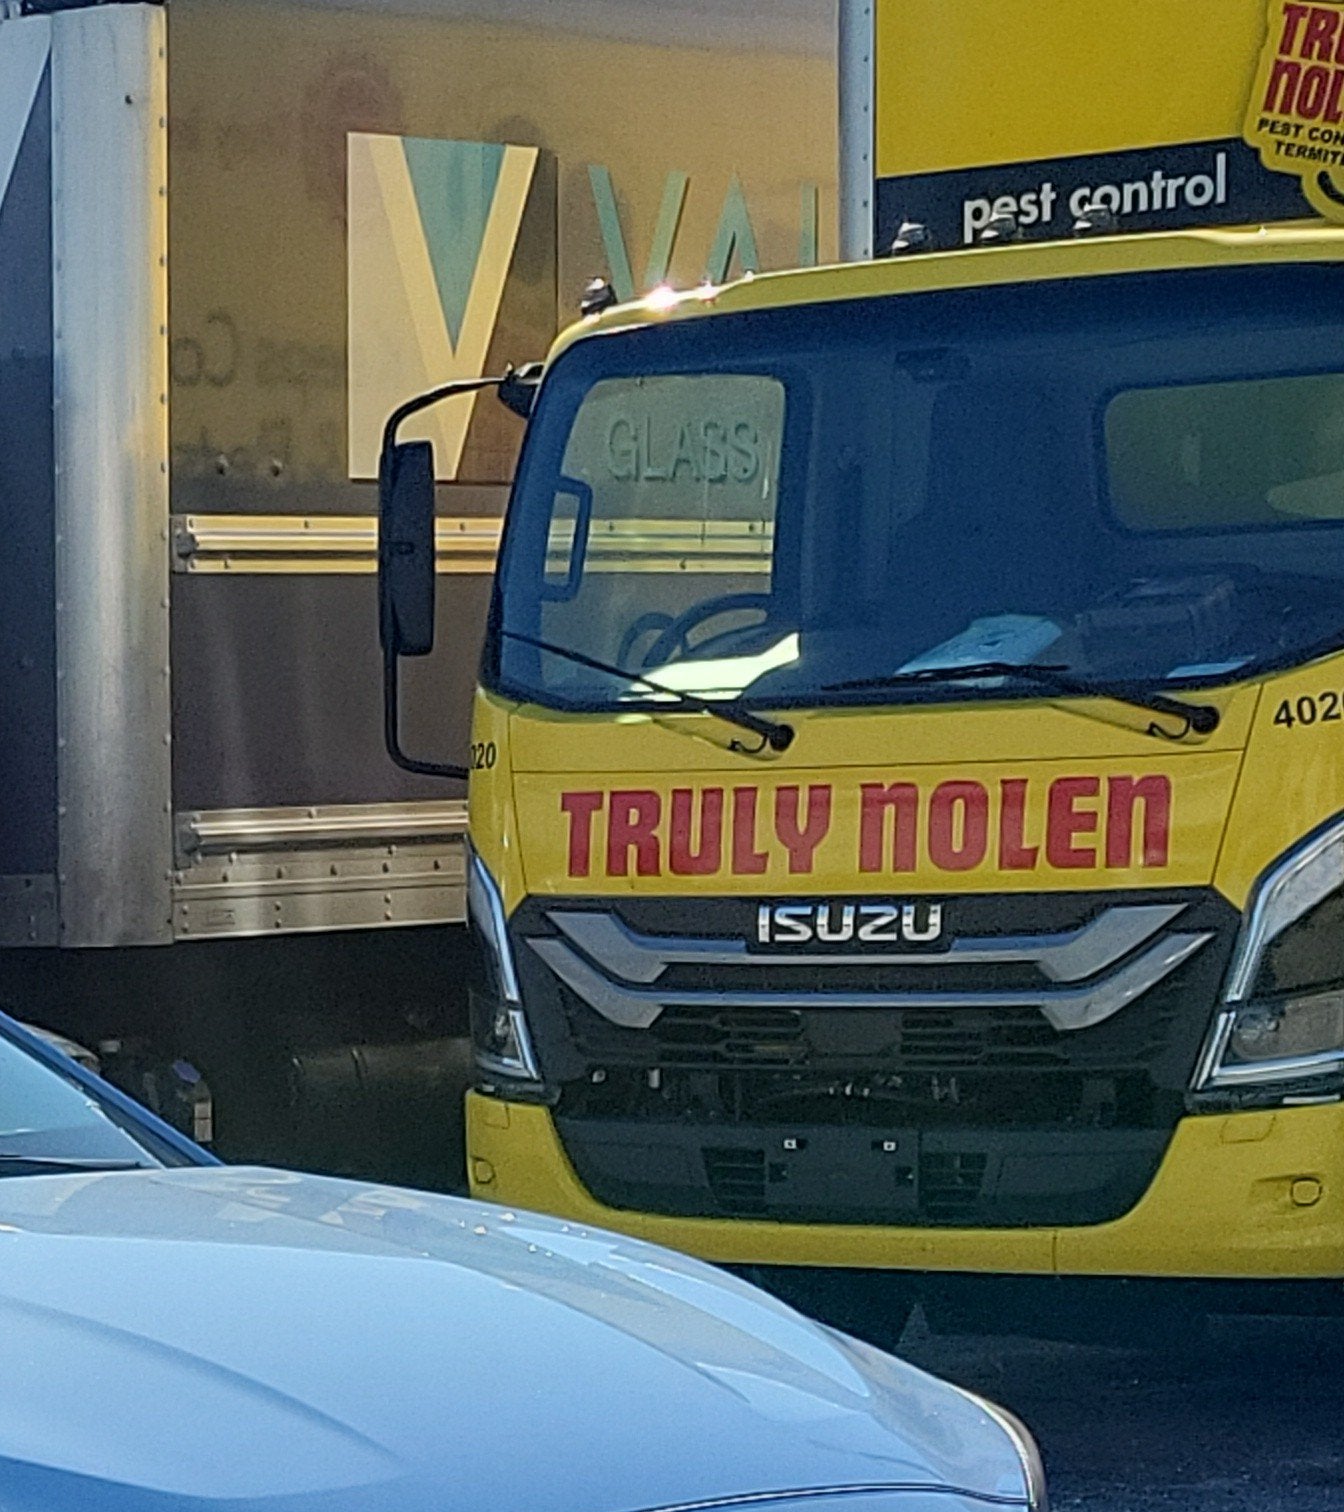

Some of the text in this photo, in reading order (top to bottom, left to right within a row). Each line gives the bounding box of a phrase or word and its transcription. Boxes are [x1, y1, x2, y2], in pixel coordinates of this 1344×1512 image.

[963, 152, 1227, 244] pest control
[1273, 690, 1344, 728] 402
[561, 773, 1173, 878] TRULY NOLEN
[758, 904, 942, 943] ISUZU
